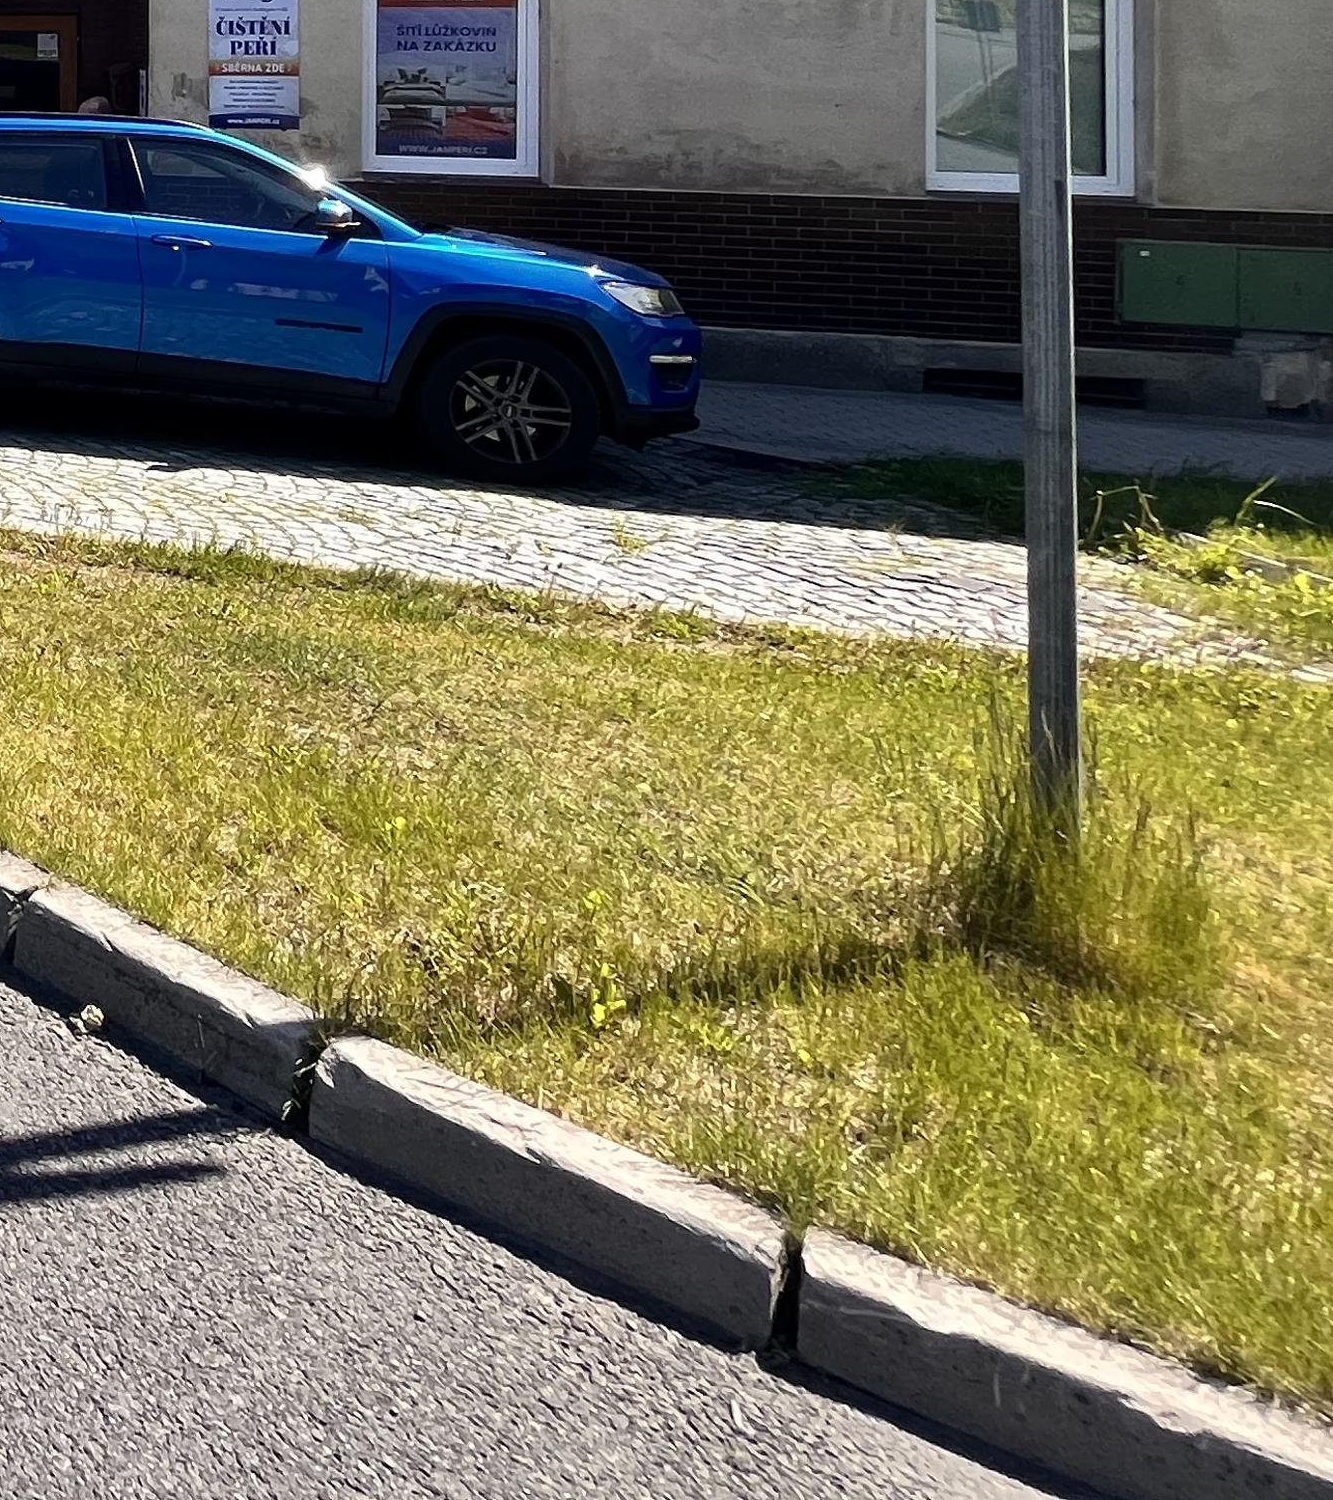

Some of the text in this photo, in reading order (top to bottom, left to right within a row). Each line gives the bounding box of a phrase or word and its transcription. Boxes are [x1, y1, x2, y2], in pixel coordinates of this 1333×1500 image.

[216, 16, 291, 36] ČIŠTĚNÍ
[230, 36, 277, 56] PEŘÍ
[396, 39, 497, 52] NA ZAKÁZKU
[221, 62, 285, 73] SBĚRNA ZDE
